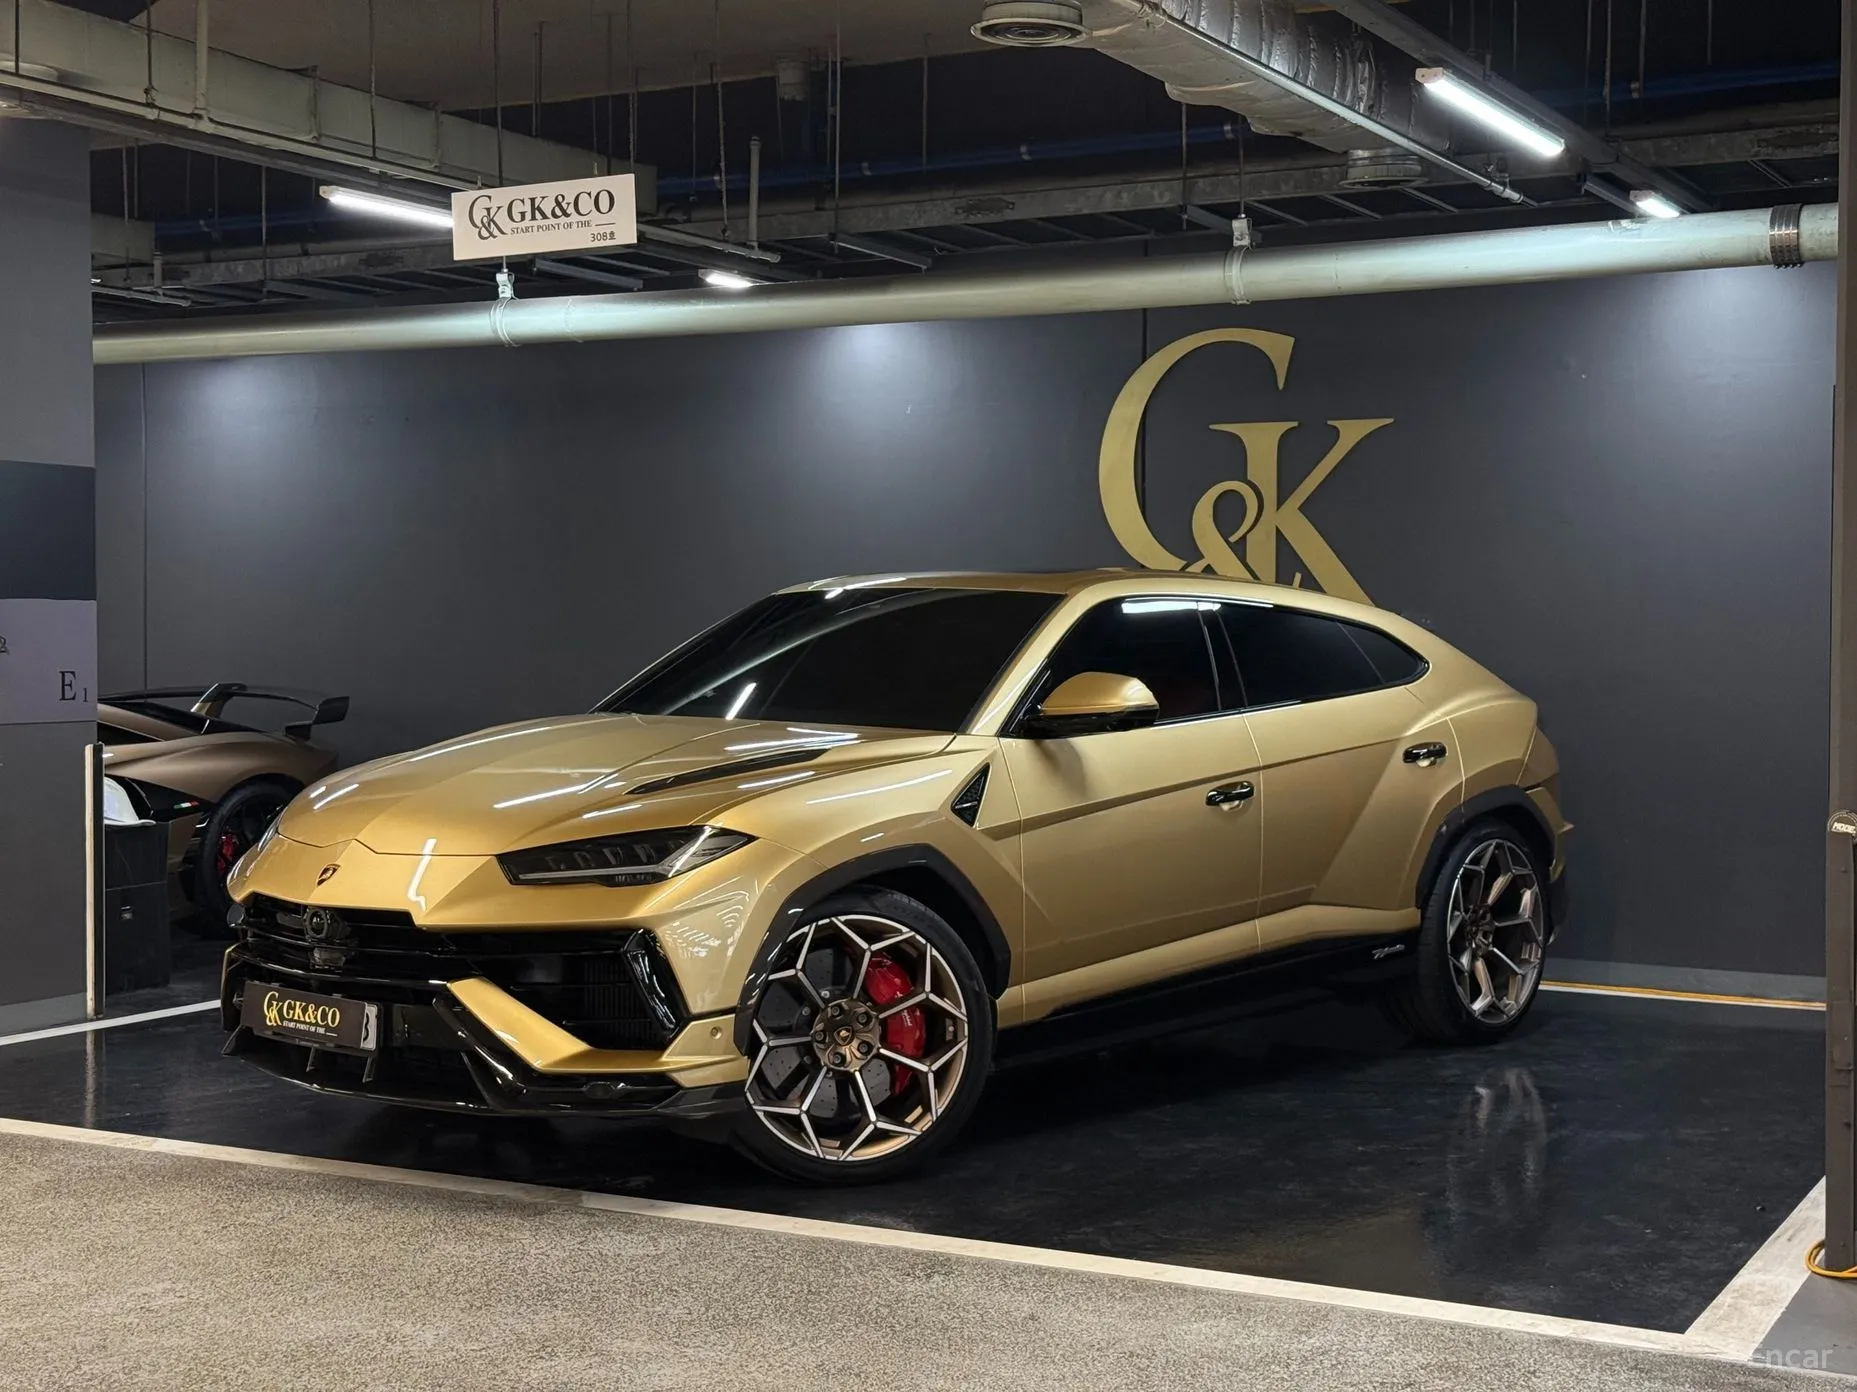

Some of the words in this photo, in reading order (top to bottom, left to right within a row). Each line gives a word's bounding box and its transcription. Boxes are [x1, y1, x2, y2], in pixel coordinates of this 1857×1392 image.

[507, 189, 615, 223] GK&CO
[510, 224, 534, 235] START
[536, 222, 561, 233] POINT
[562, 221, 575, 230] OF
[575, 219, 592, 228] THE
[590, 231, 616, 242] 308호
[282, 999, 341, 1028] GK&CO
[309, 1025, 316, 1033] OF
